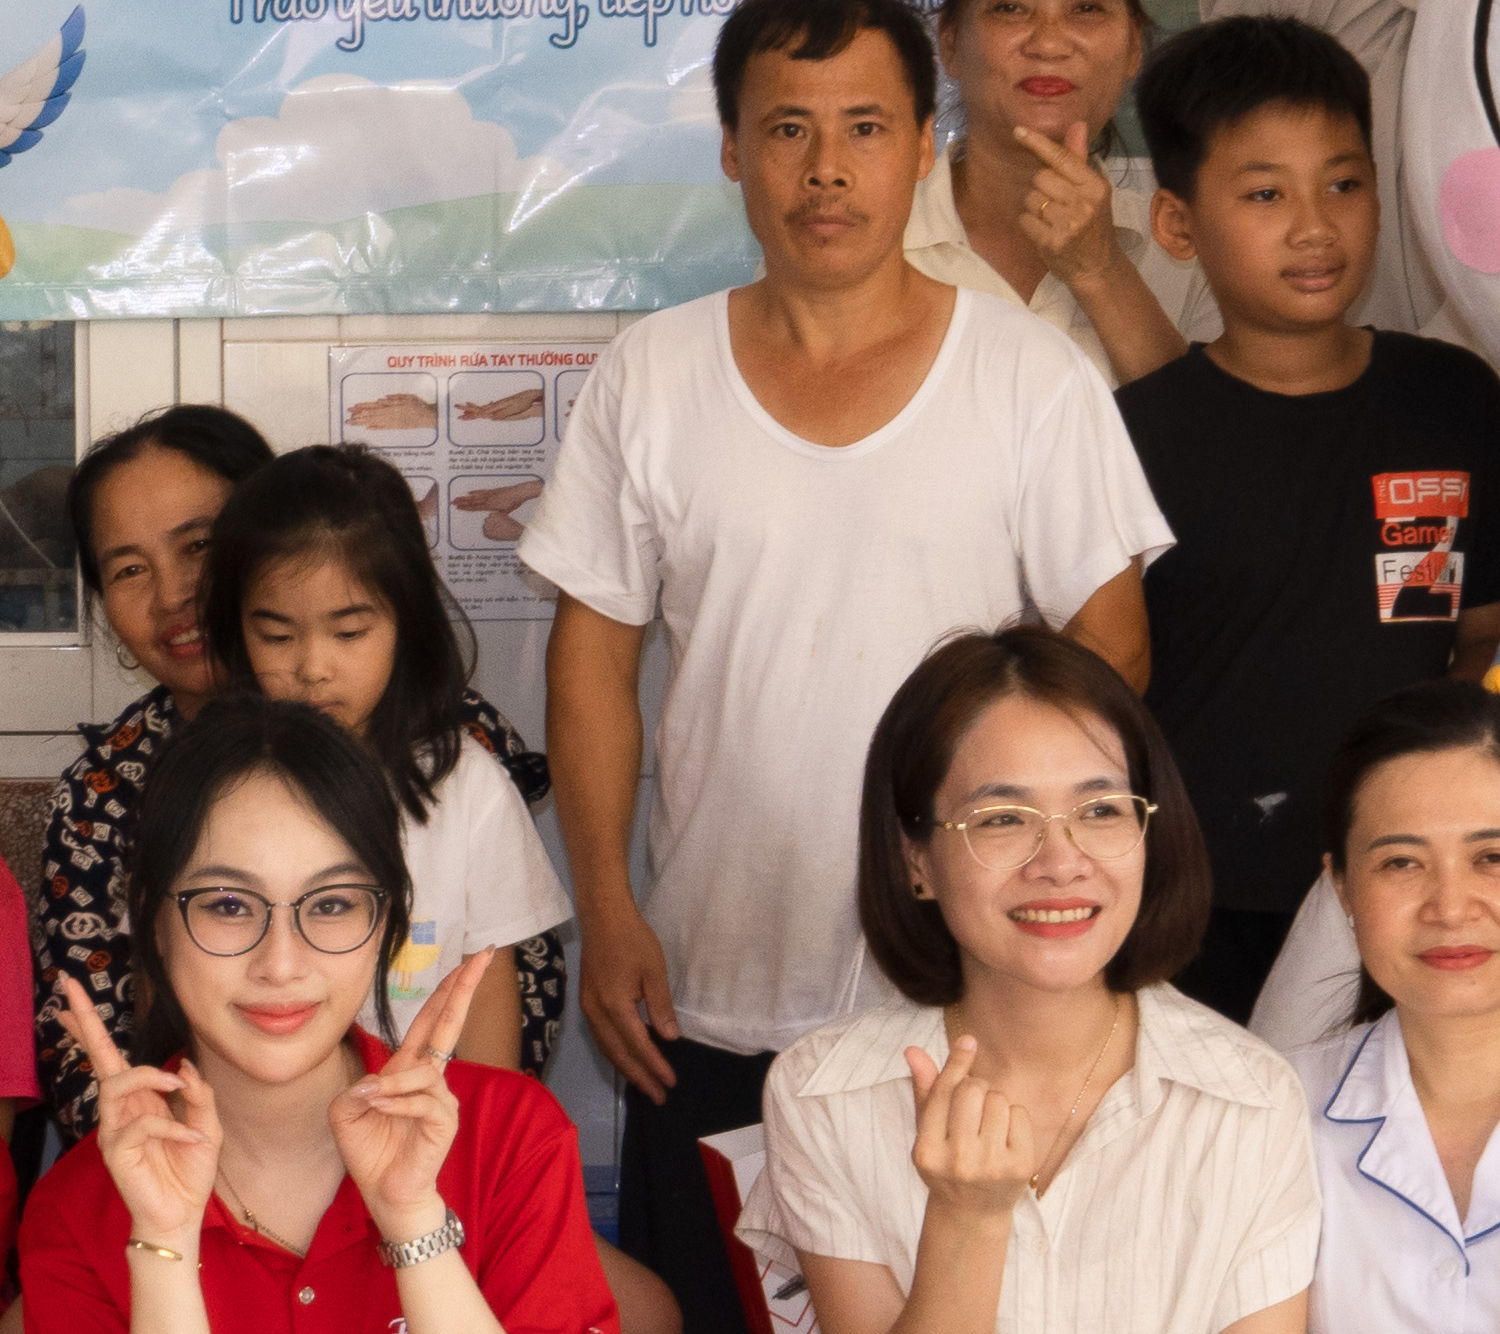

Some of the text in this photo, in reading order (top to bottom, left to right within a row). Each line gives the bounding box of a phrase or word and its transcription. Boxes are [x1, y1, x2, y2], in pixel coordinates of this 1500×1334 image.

[388, 356, 416, 369] QUY
[417, 356, 456, 368] TRÌNH
[461, 353, 489, 367] RỬA
[490, 354, 517, 367] TAY
[518, 351, 574, 367] THƯỜNG
